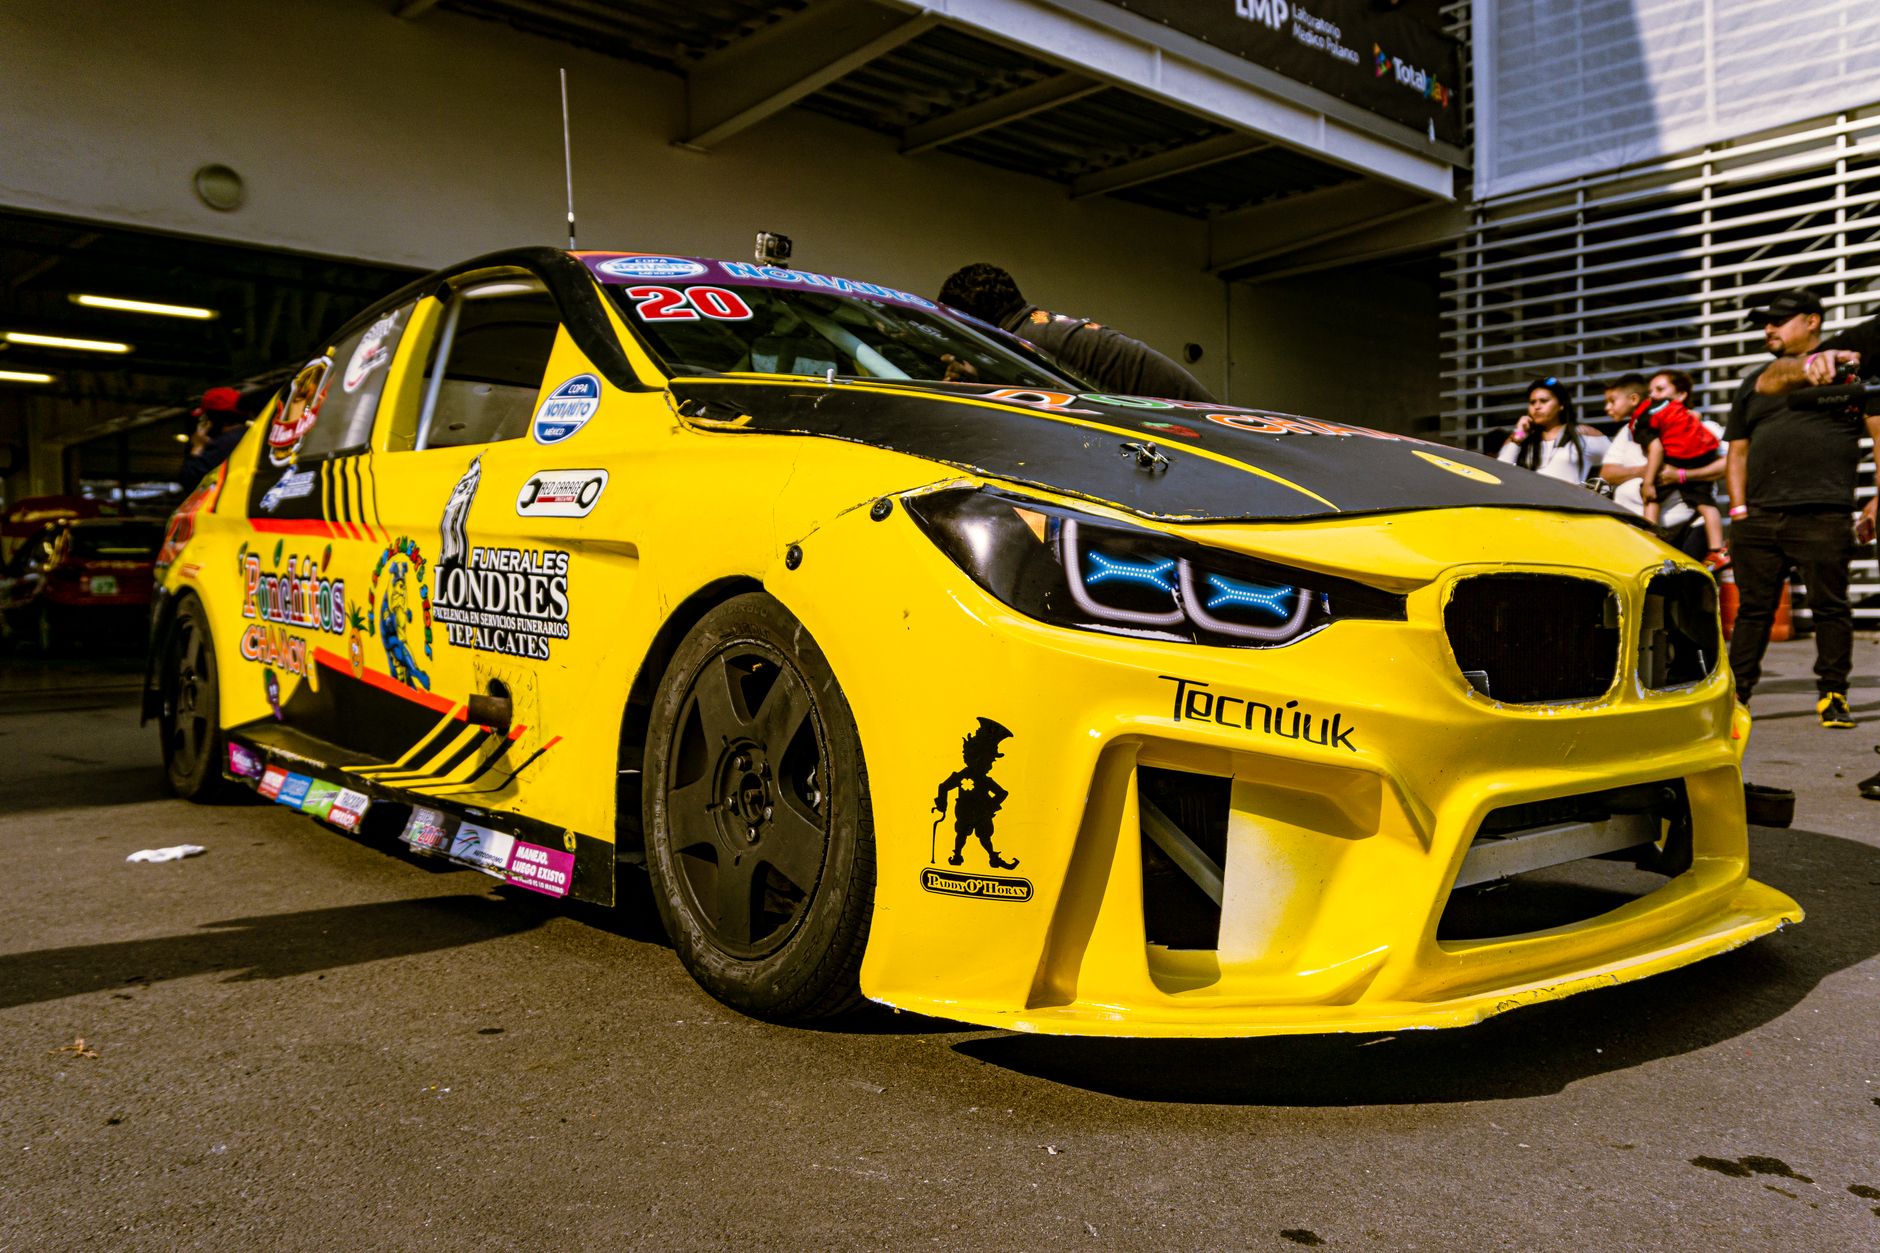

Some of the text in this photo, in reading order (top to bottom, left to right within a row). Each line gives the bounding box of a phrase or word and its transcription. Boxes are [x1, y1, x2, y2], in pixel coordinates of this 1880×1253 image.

[1235, 0, 1289, 30] LMP
[625, 286, 754, 323] 20
[567, 383, 589, 394] COPA
[470, 548, 570, 577] FUNERALES
[243, 554, 345, 635] Ponchitos
[432, 566, 569, 621] LONDRES
[447, 623, 550, 659] TEPALCATES
[469, 611, 480, 623] EN
[480, 613, 516, 628] SERVICIOS
[517, 618, 569, 638] FUNERARIOS
[1158, 675, 1357, 752] Tecnúuk
[511, 860, 537, 876] LUEGO
[537, 866, 566, 885] EXISTO
